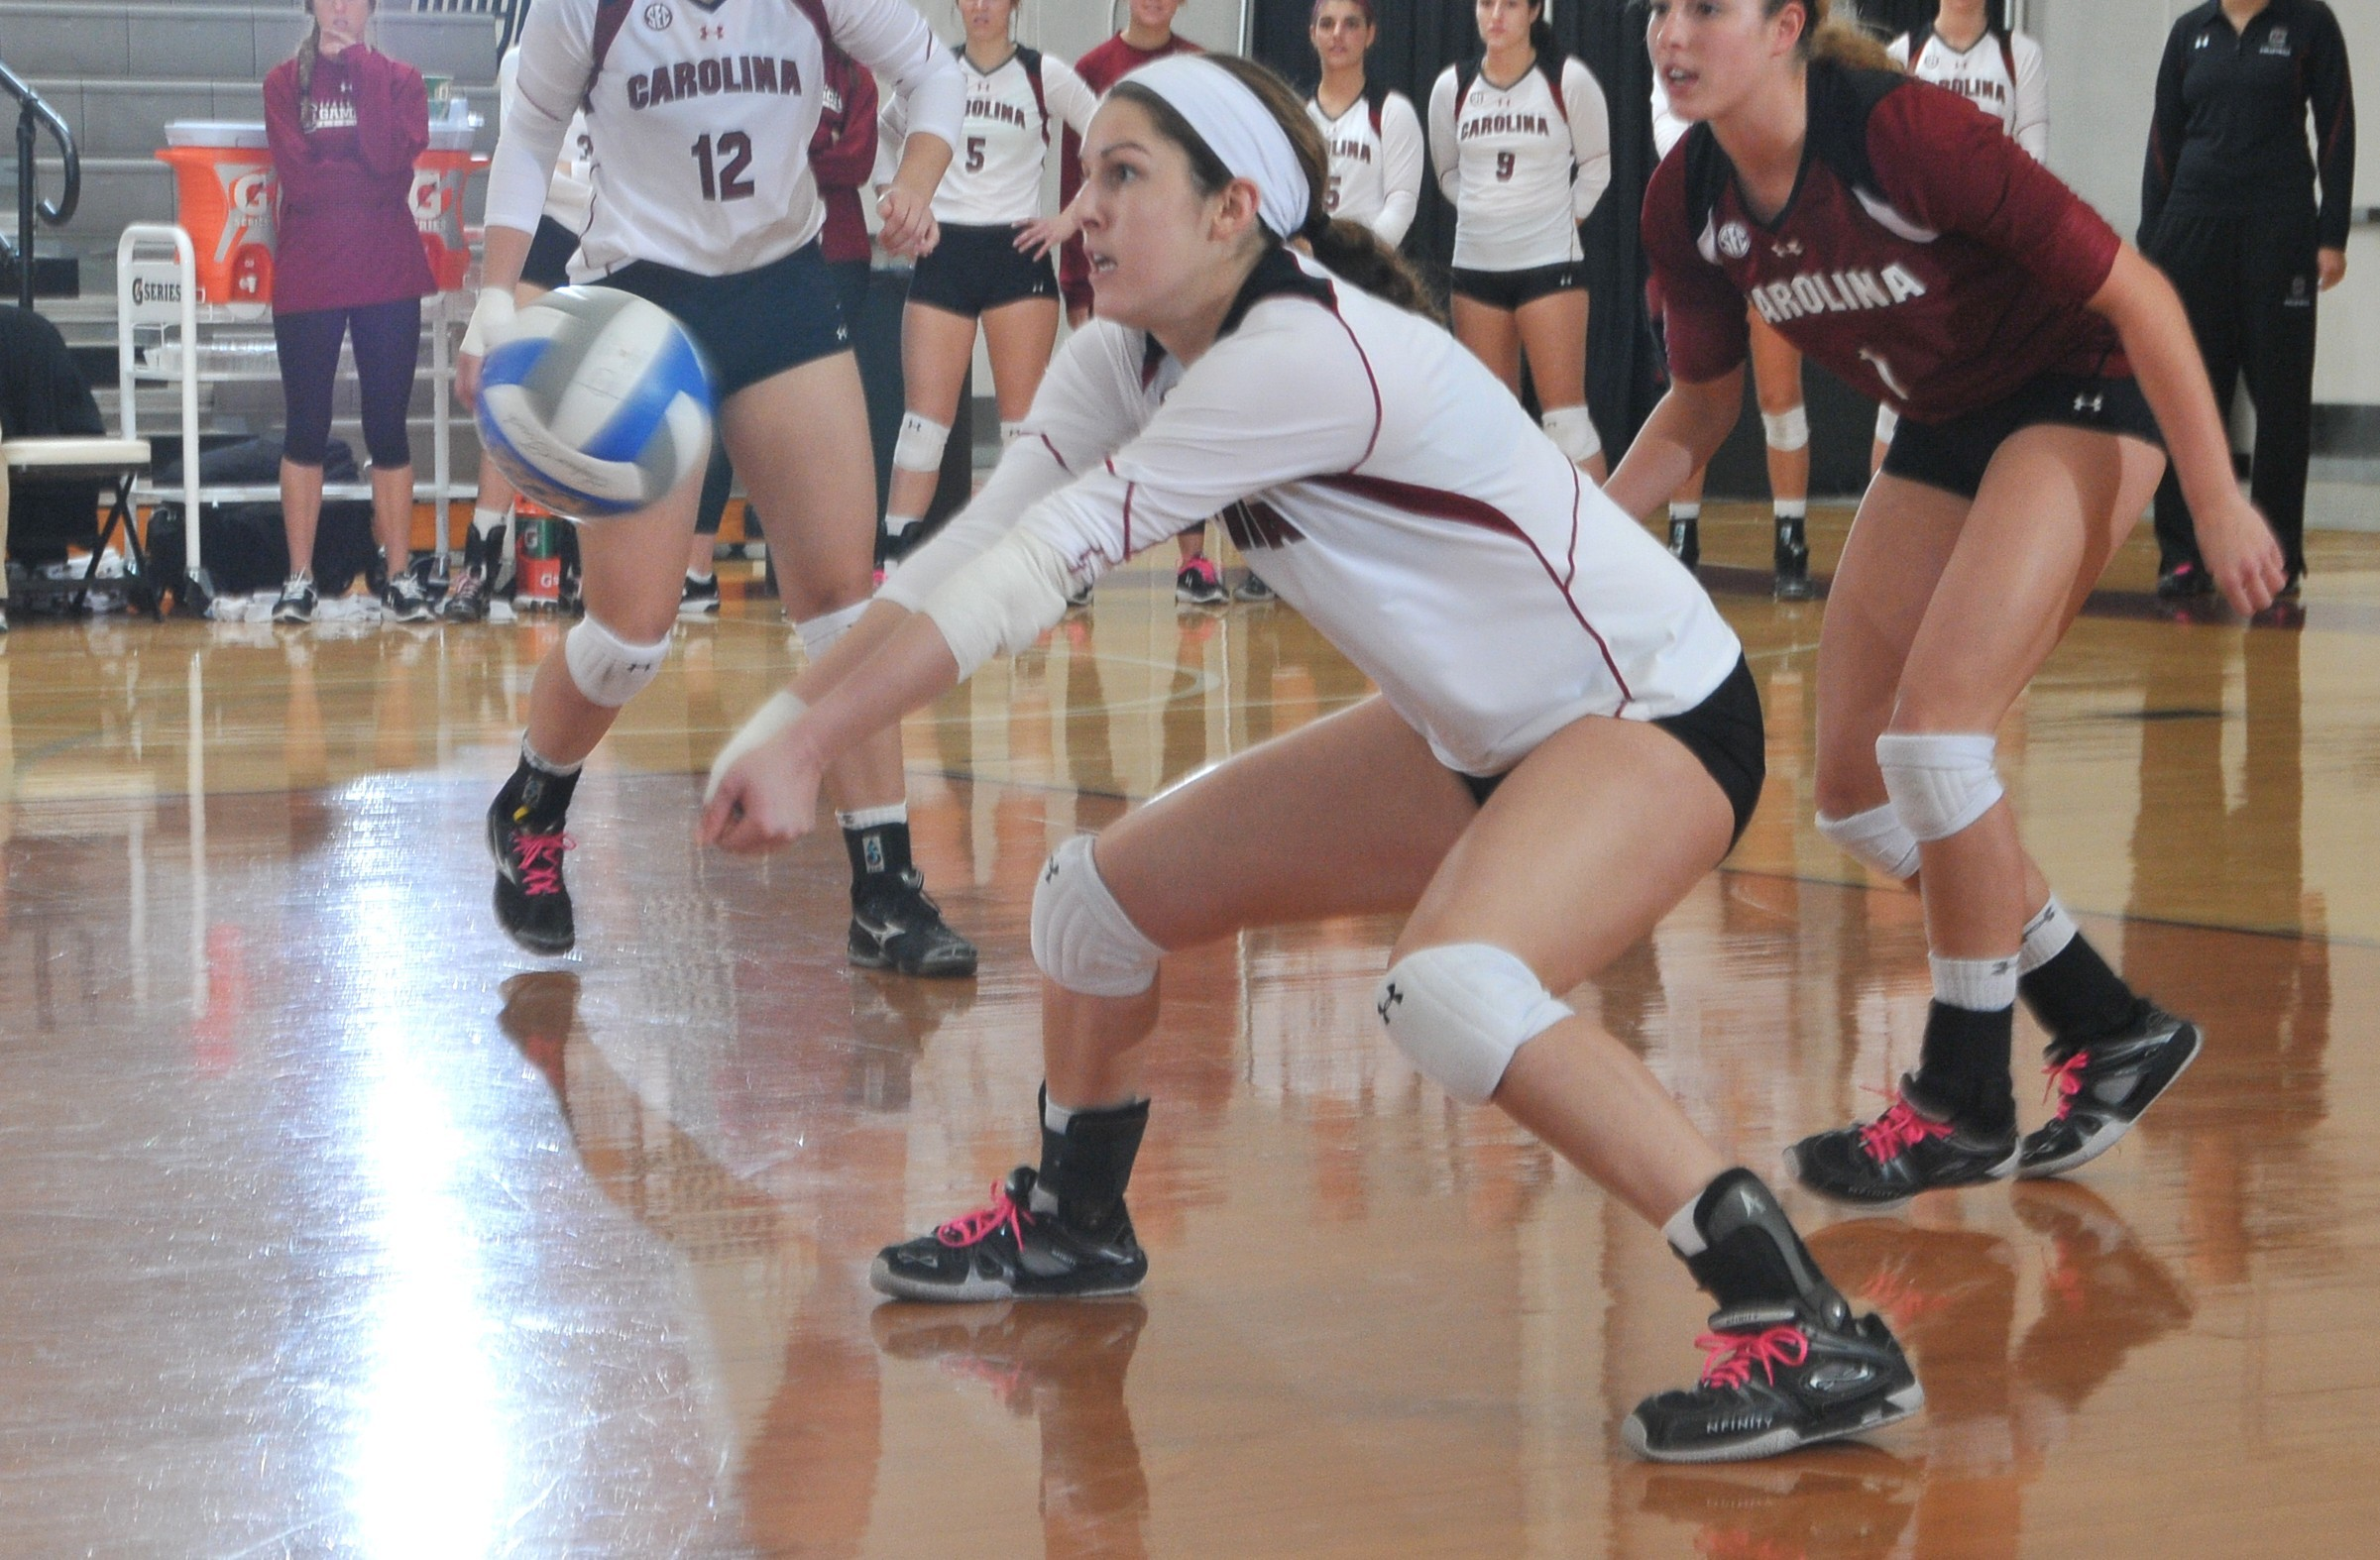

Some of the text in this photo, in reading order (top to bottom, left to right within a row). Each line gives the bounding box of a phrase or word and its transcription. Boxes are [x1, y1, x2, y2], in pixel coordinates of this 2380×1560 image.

[646, 4, 672, 30] SEC
[626, 56, 802, 111] CAROLINA
[1461, 114, 1549, 141] CAROLINA
[691, 130, 754, 202] 12
[965, 137, 986, 172] 5
[1496, 151, 1516, 182] 9
[235, 173, 268, 217] G
[408, 170, 441, 219] G
[133, 278, 180, 305] G SERIES
[1859, 348, 1909, 399] 1
[1706, 1417, 1773, 1434] NFINITY
